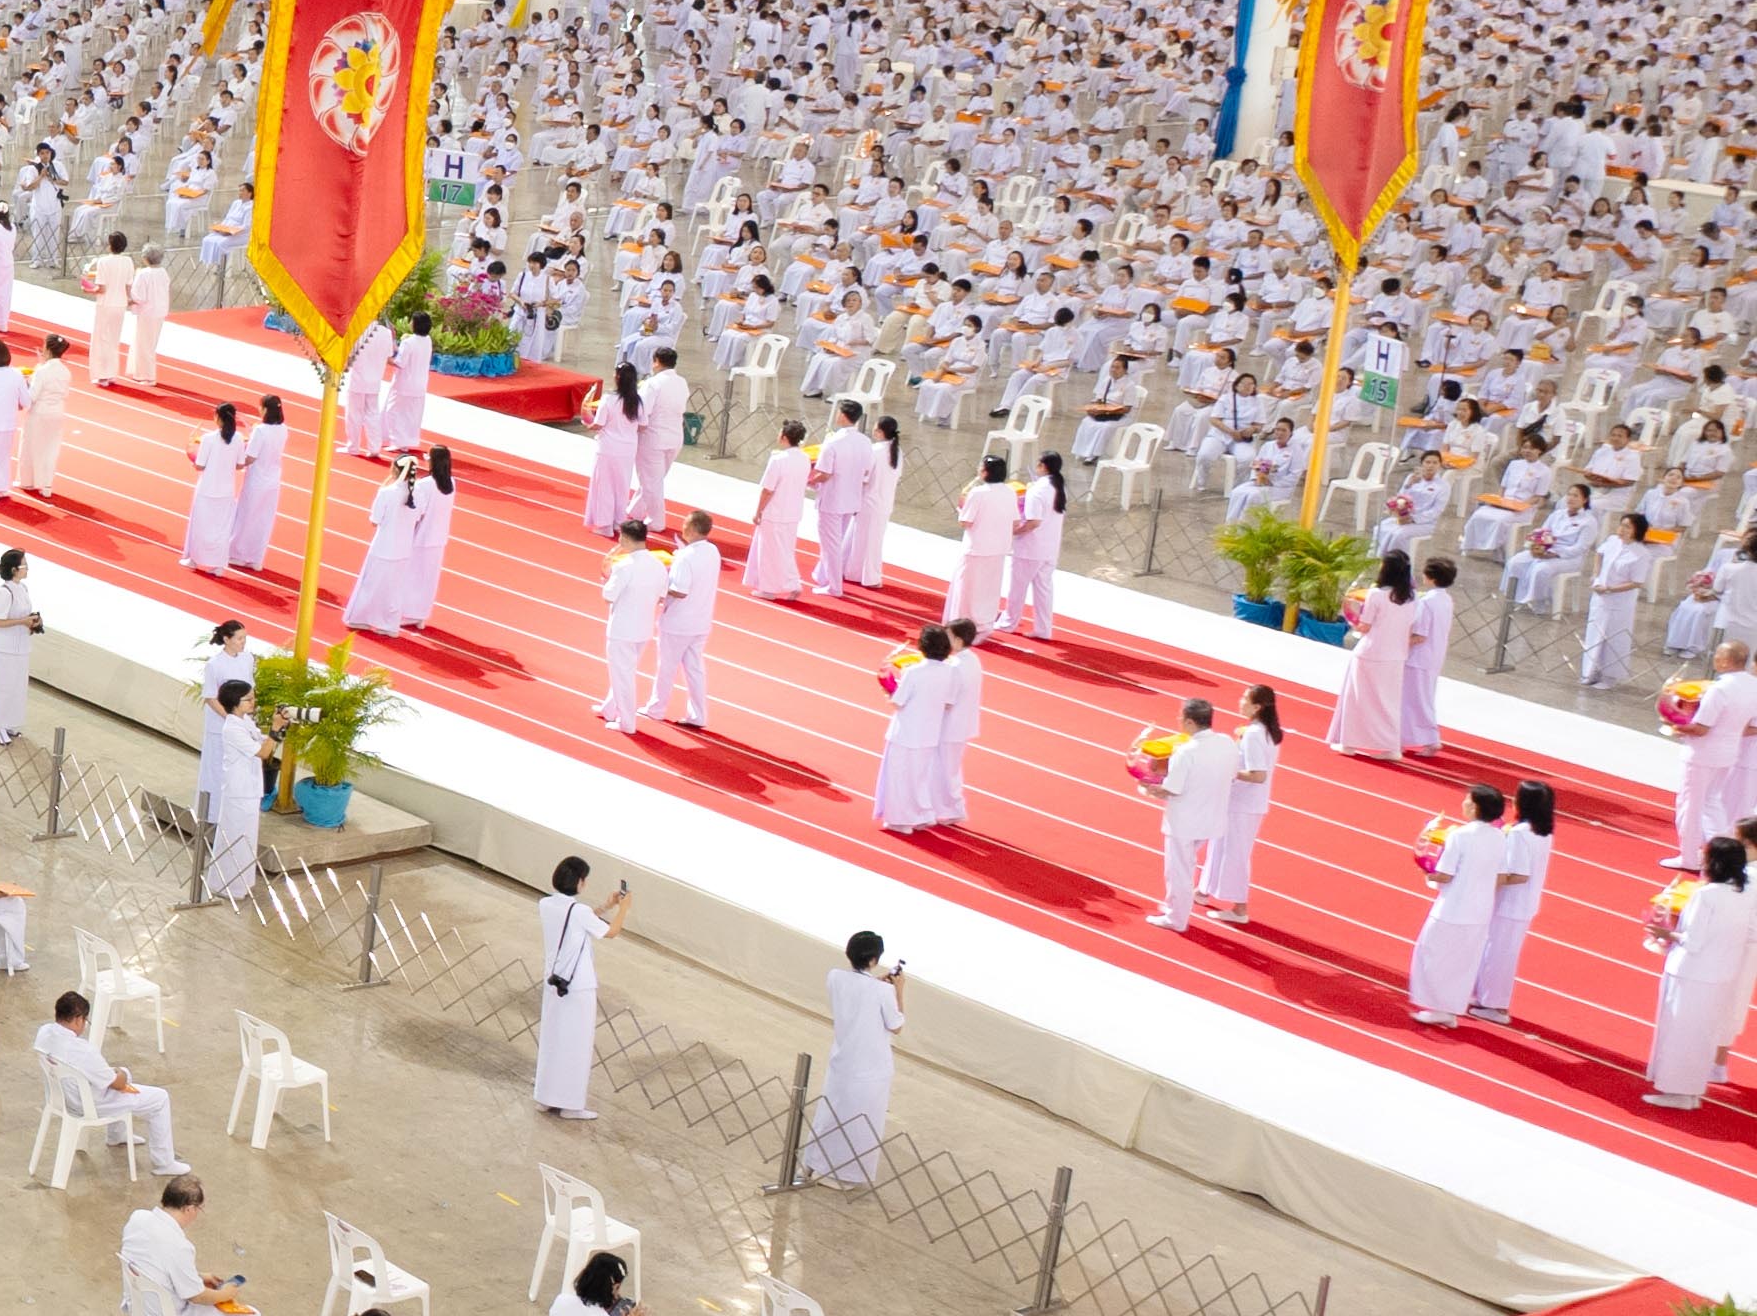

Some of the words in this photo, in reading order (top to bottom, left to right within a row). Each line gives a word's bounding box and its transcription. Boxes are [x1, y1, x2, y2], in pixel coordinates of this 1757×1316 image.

[444, 154, 464, 180] H
[439, 183, 463, 203] 17
[1375, 339, 1391, 374] H
[1370, 377, 1389, 403] 15
